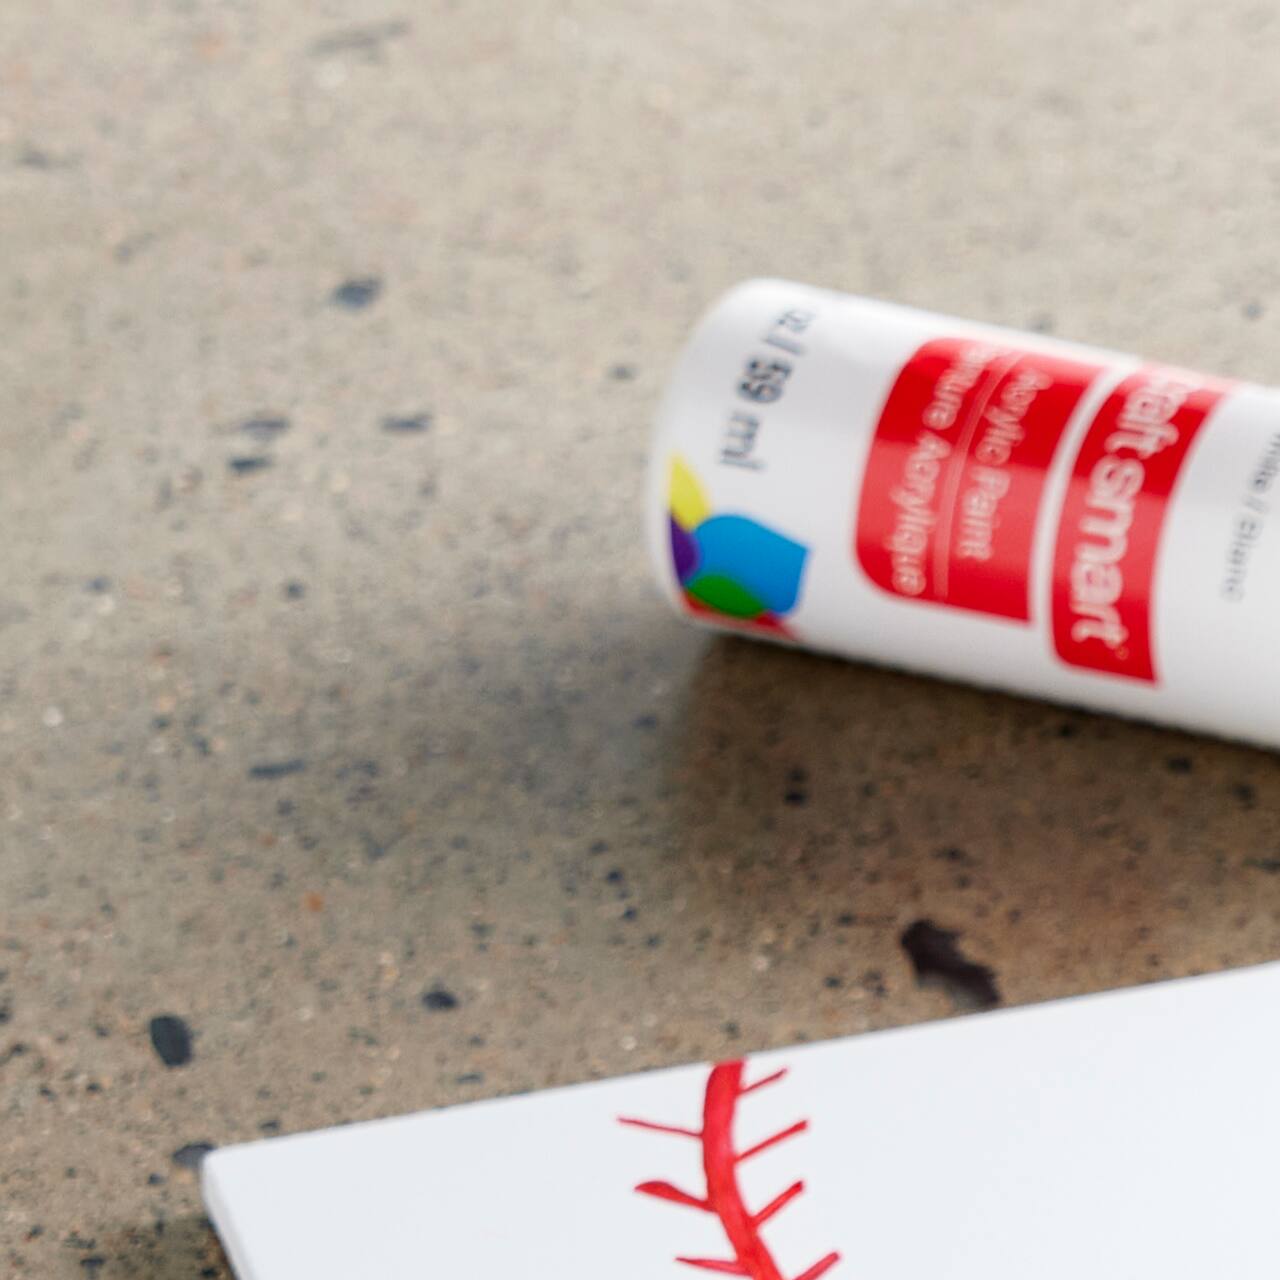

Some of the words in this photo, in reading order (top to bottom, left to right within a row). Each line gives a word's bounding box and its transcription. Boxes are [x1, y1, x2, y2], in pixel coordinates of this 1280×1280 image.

[738, 357, 794, 403] 59
[976, 367, 1052, 465] Acrylic
[720, 411, 768, 471] ml
[888, 431, 950, 596] Acrylique
[960, 465, 1011, 561] Paint
[1068, 452, 1146, 642] smart
